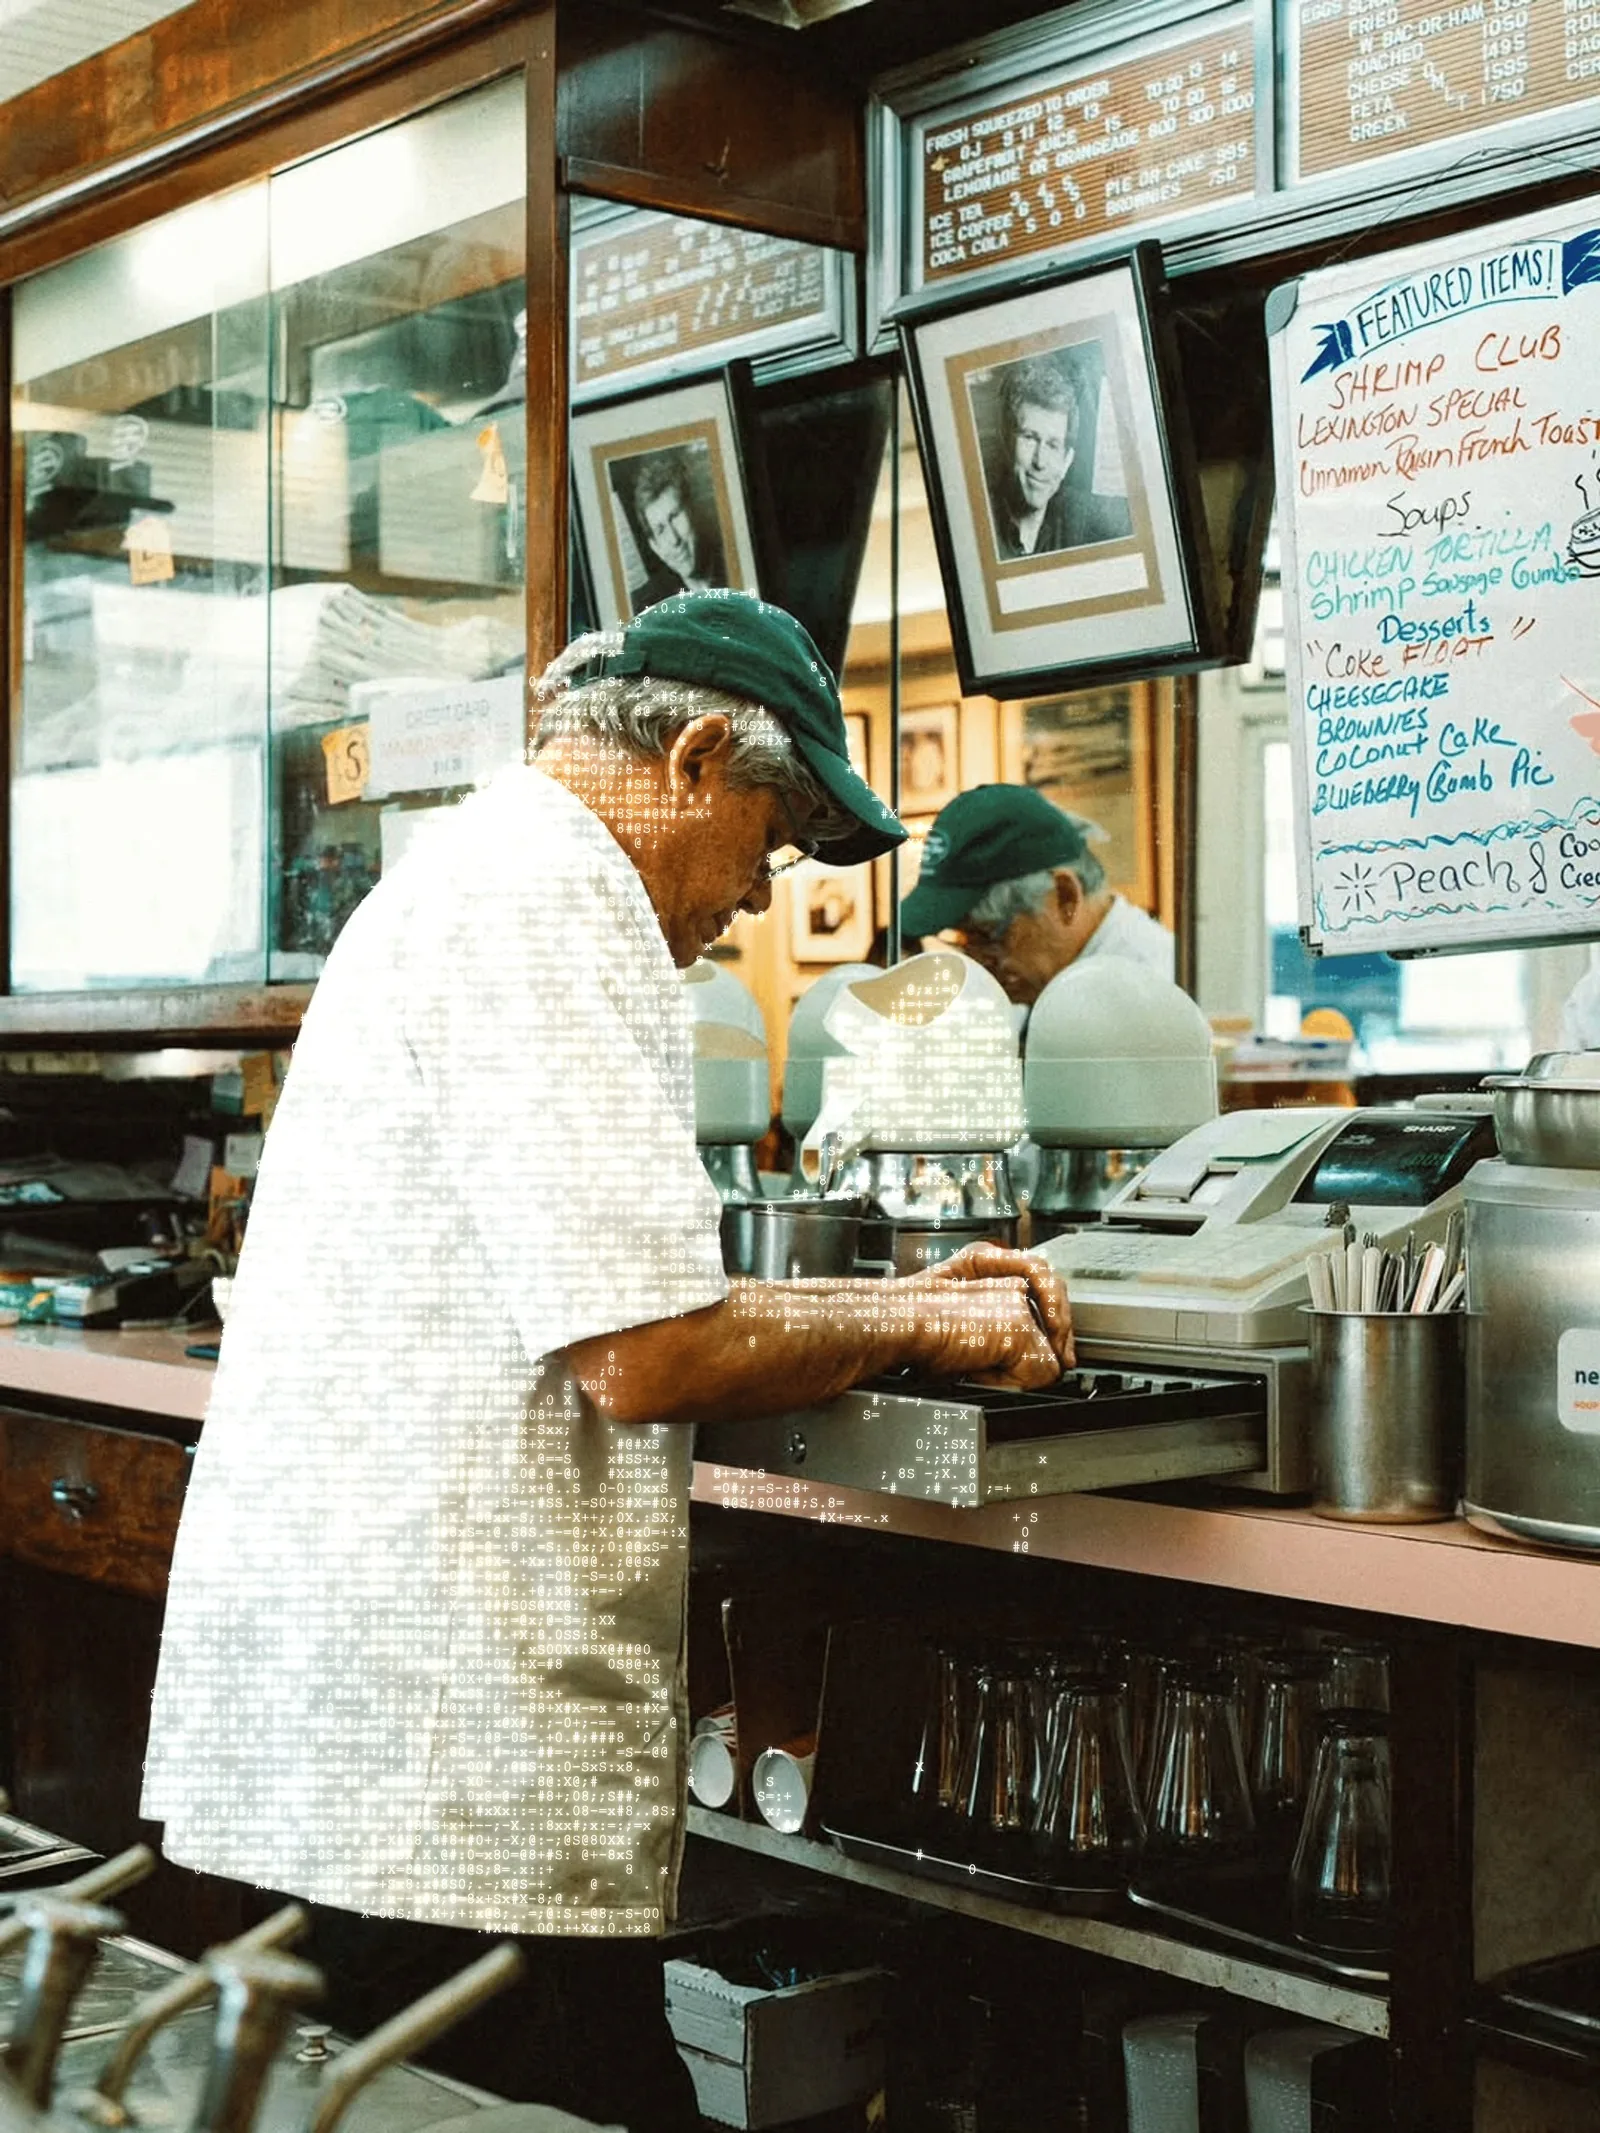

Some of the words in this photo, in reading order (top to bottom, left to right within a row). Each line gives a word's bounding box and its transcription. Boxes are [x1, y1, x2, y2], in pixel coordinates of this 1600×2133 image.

[1347, 42, 1424, 80] POACHED
[1483, 10, 1529, 39] 1050
[1349, 7, 1399, 38] FRIED
[1347, 67, 1412, 100] CHEESE
[1351, 95, 1393, 121] FETA
[1484, 55, 1529, 83] 1595
[926, 127, 968, 153] FRESH
[971, 103, 1042, 137] SQUEEZED
[1044, 95, 1062, 112] TO
[1065, 80, 1109, 106] ORDER
[1350, 112, 1407, 142] GREEK
[942, 144, 1026, 185] GRAPEFRUIT
[1034, 128, 1077, 155] JUICE
[944, 165, 1021, 202] LEMONADE
[1029, 157, 1048, 175] OR
[1055, 128, 1140, 167] ORANGEADE
[1105, 176, 1133, 197] PIE
[1139, 169, 1161, 187] OR
[1105, 181, 1181, 217] BROWNIES
[929, 211, 953, 232] ICE
[958, 202, 984, 222] TEA
[930, 229, 954, 249] ICE
[958, 211, 1014, 241] COFFEE
[930, 245, 966, 268] COCA
[971, 232, 1009, 255] COLA
[1356, 267, 1471, 347] FEATURED
[1481, 248, 1554, 291] ITEMS!
[1328, 354, 1445, 410] SHRIMP
[1298, 402, 1418, 450] LEXINGTON
[1427, 387, 1527, 427] SPECIAL
[1386, 491, 1471, 535] Soups
[1306, 545, 1413, 588] CHICKEN
[1425, 521, 1553, 569] TORTILLA
[1310, 577, 1416, 621] Shrimp
[1421, 565, 1503, 597] Sausage
[1511, 552, 1581, 590] Gumbo
[1377, 598, 1491, 644] Desserts
[1306, 673, 1449, 717] CHEESECAKE
[1317, 707, 1429, 747] BROWNIES
[1379, 851, 1521, 900] Peach
[1403, 1125, 1456, 1133] SHARP
